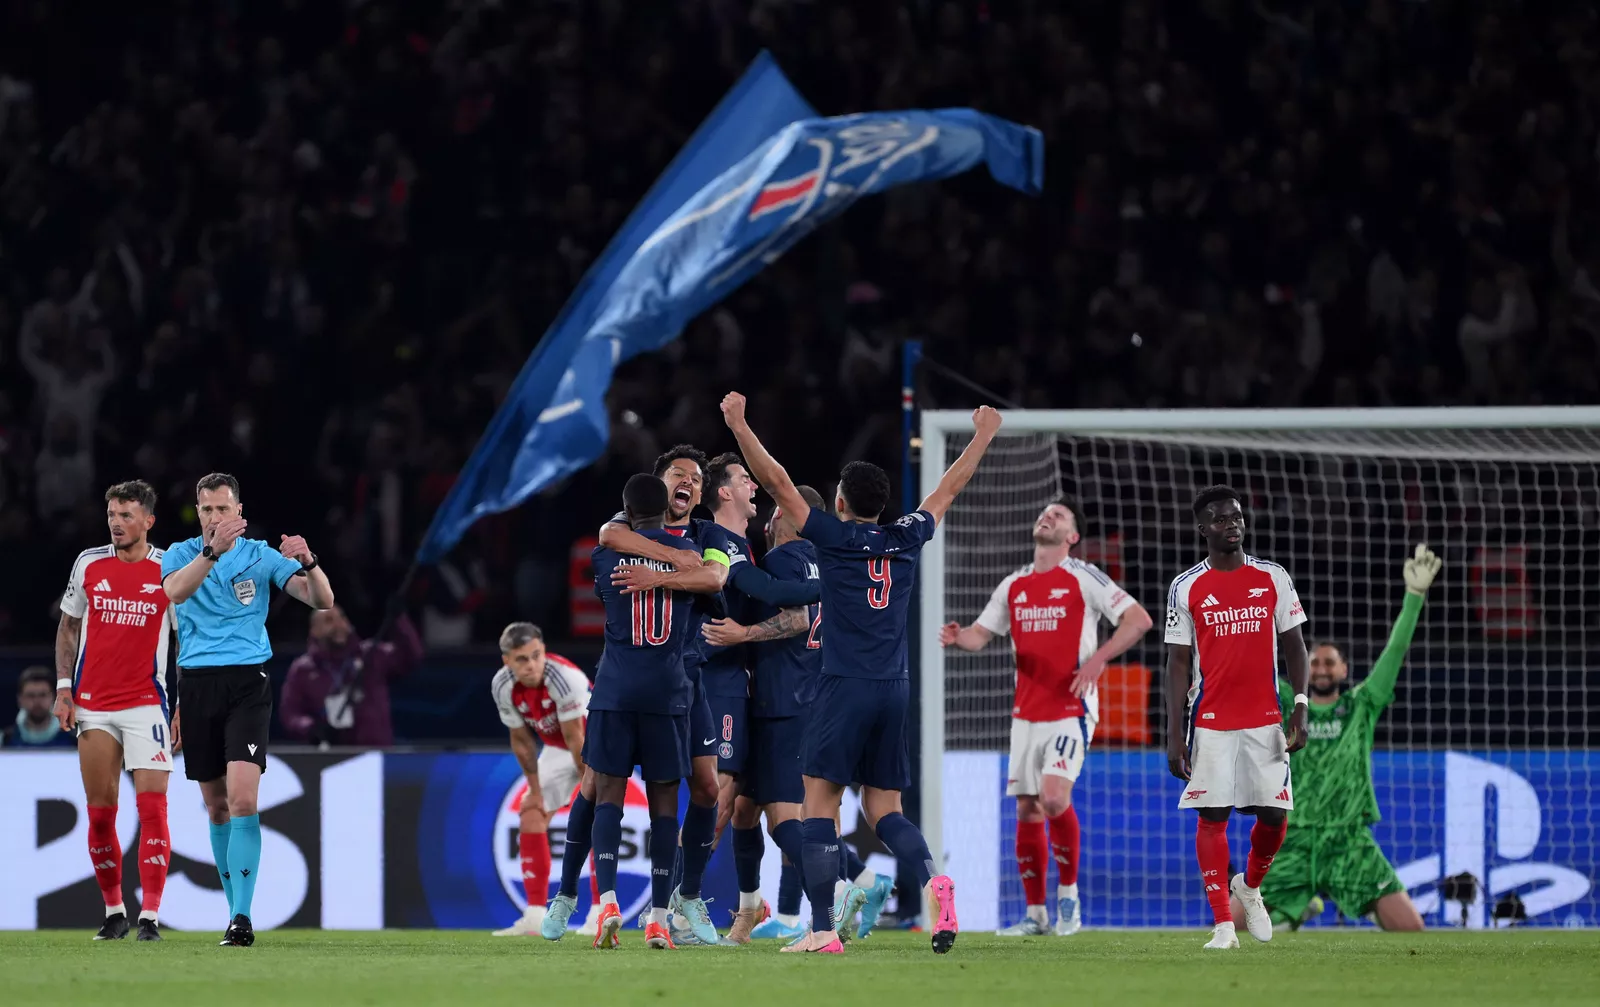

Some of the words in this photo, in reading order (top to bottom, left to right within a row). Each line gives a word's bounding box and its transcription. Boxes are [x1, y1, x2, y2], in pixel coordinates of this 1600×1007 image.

[867, 553, 892, 610] 9
[93, 595, 158, 615] Emirates
[1015, 605, 1067, 621] Emirates
[101, 611, 115, 623] FLY
[116, 613, 147, 627] BETTER
[627, 585, 673, 647] 10
[1203, 605, 1268, 626] Emirates
[1021, 620, 1032, 632] FLY
[1033, 619, 1058, 632] BETTER
[1215, 623, 1229, 637] FLY
[1231, 621, 1261, 635] BETTER
[152, 723, 166, 749] 4
[722, 714, 733, 742] 8
[1055, 734, 1078, 760] 41
[90, 844, 113, 854] AFC
[146, 838, 167, 846] AFC
[598, 853, 615, 861] PARIS
[653, 868, 669, 876] PARIS
